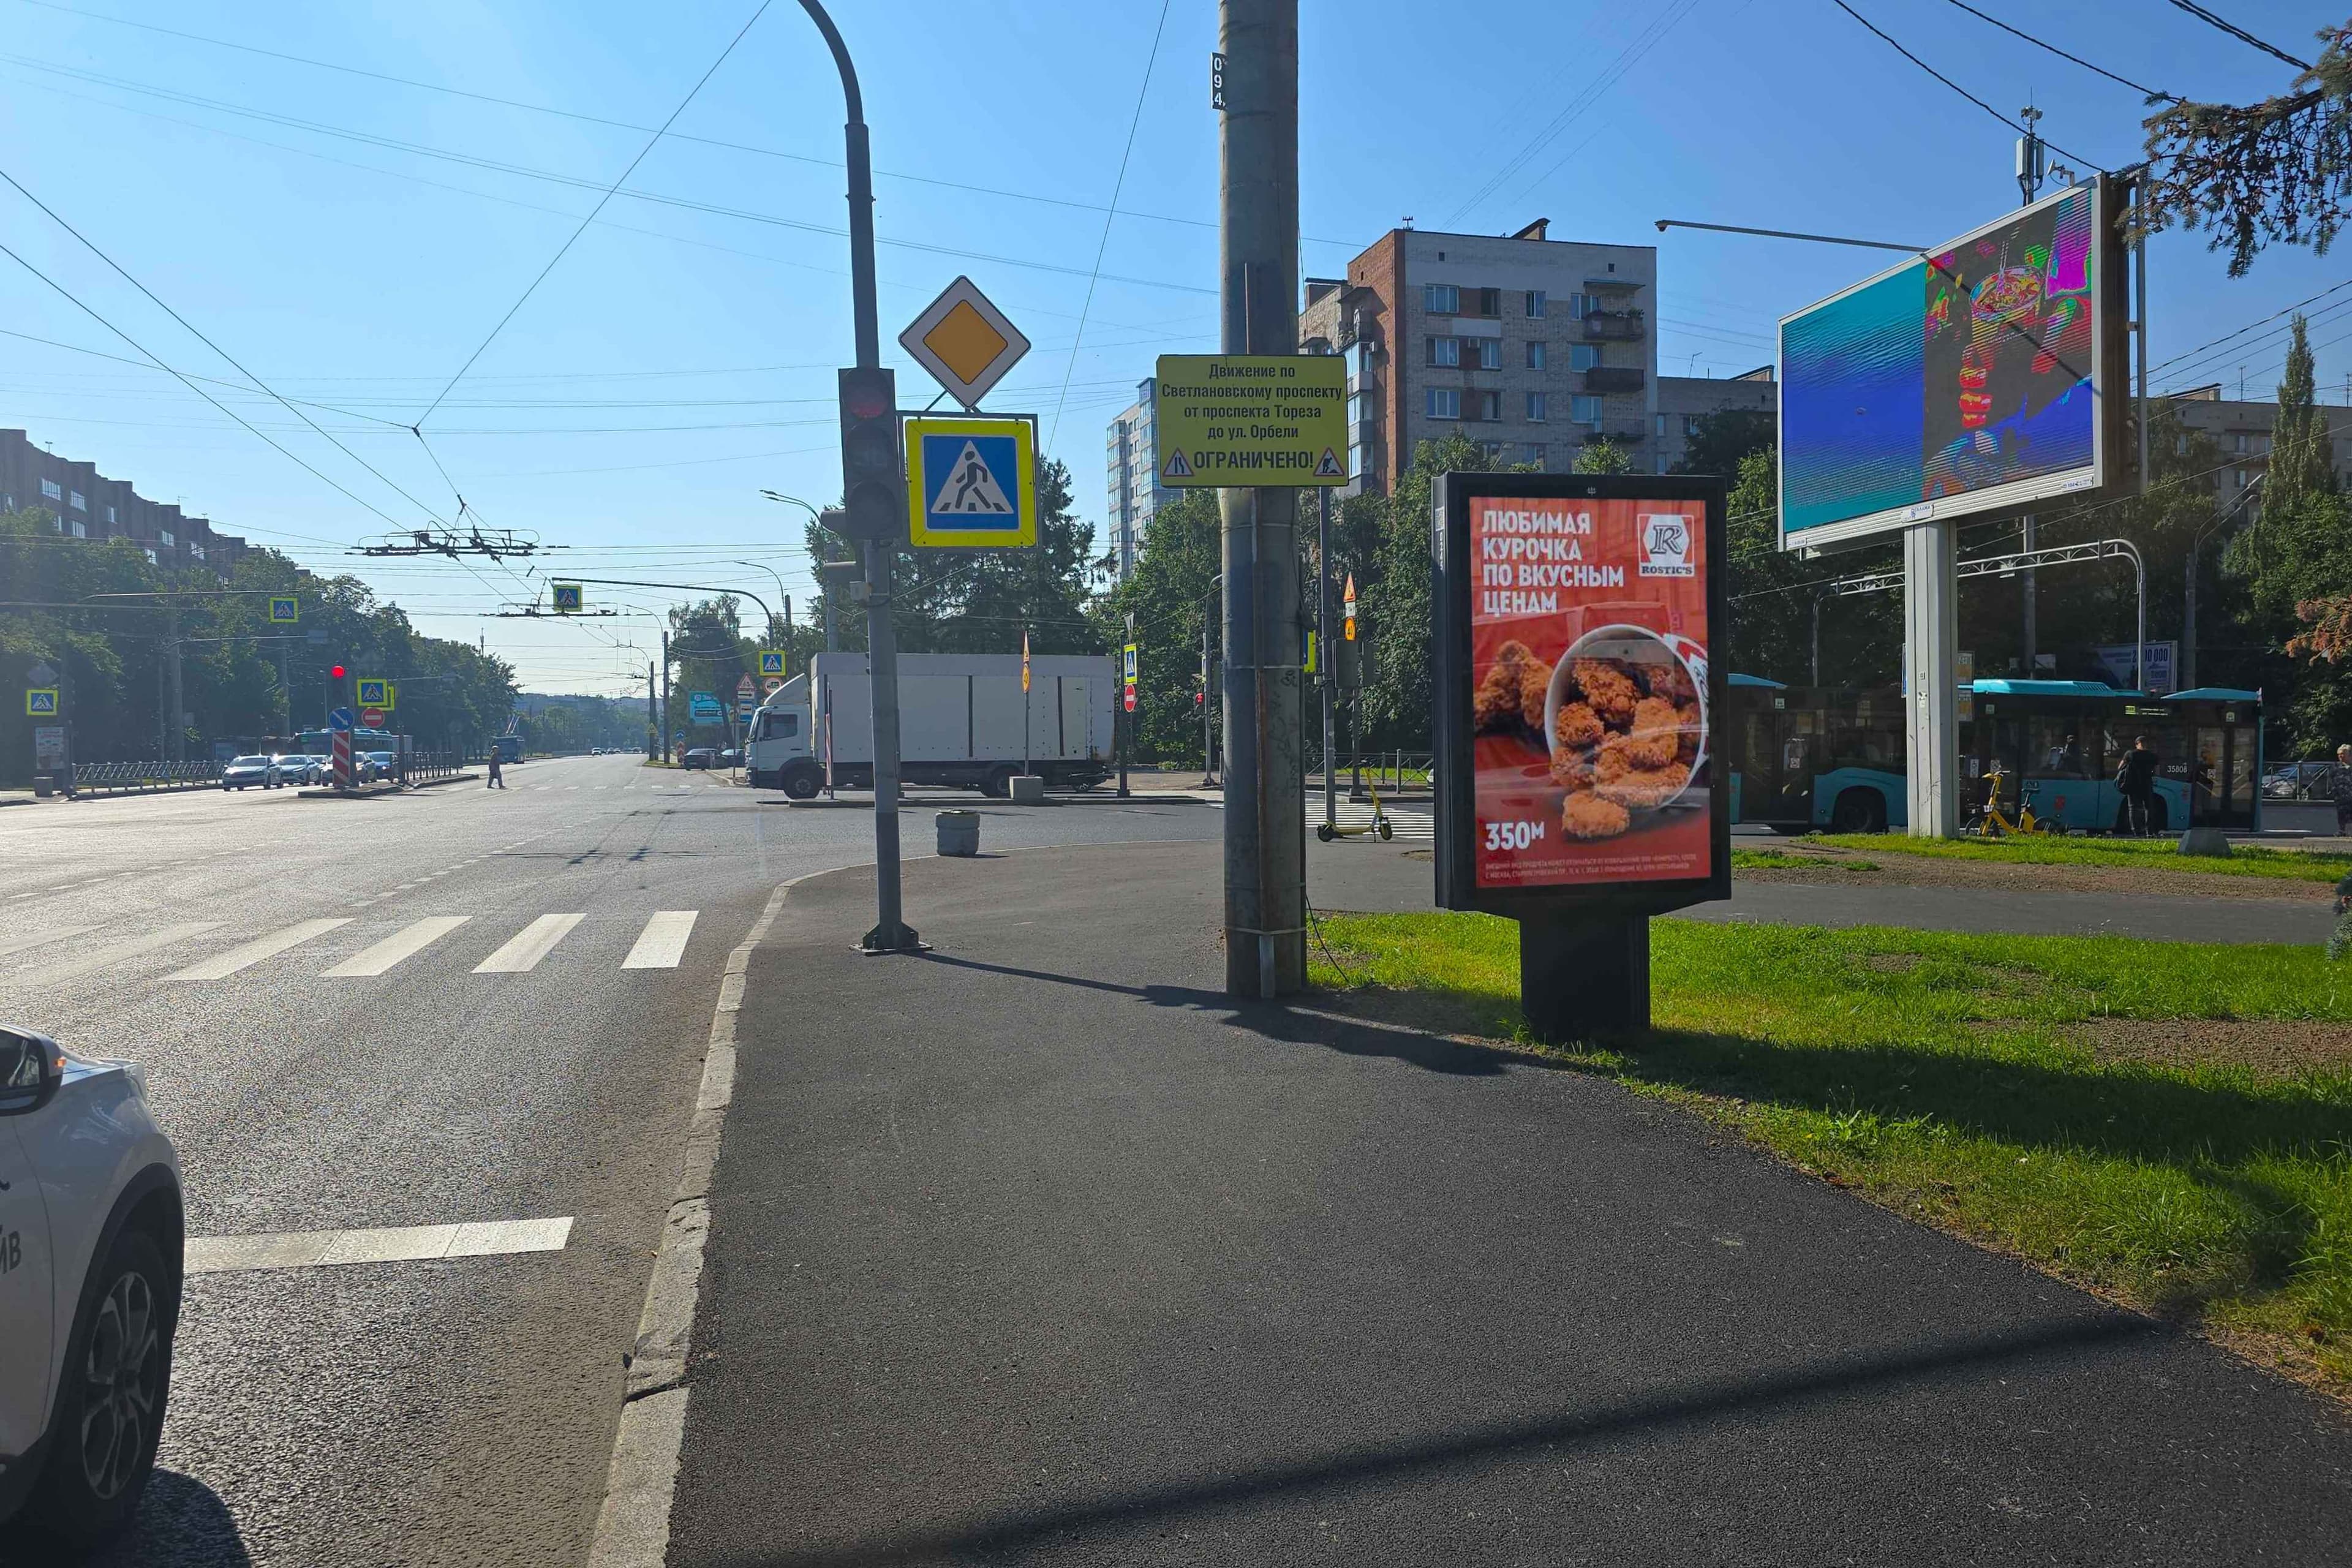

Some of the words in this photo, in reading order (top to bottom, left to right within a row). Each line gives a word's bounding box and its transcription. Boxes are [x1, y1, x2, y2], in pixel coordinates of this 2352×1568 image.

[1209, 364, 1275, 379] Движение
[1281, 368, 1295, 377] по
[1162, 383, 1271, 400] Светлановскому
[1276, 388, 1341, 400] проспекту
[1185, 408, 1198, 418] от
[1203, 408, 1270, 420] проспекта
[1274, 405, 1321, 420] Тореза
[1208, 428, 1224, 440] до
[1229, 428, 1246, 440] ул.
[1251, 424, 1298, 440] Орбели
[1194, 451, 1313, 469] ОГРАНИЧЕНО!
[1482, 510, 1591, 534] ЛЮБИМАЯ
[1483, 538, 1582, 560] КУРОЧКА
[1484, 564, 1512, 586] ПО
[1519, 565, 1624, 587] ВКУСНЫМ
[1642, 566, 1693, 575] ROSTIC'S
[1483, 591, 1557, 617] ЦЕНАМ
